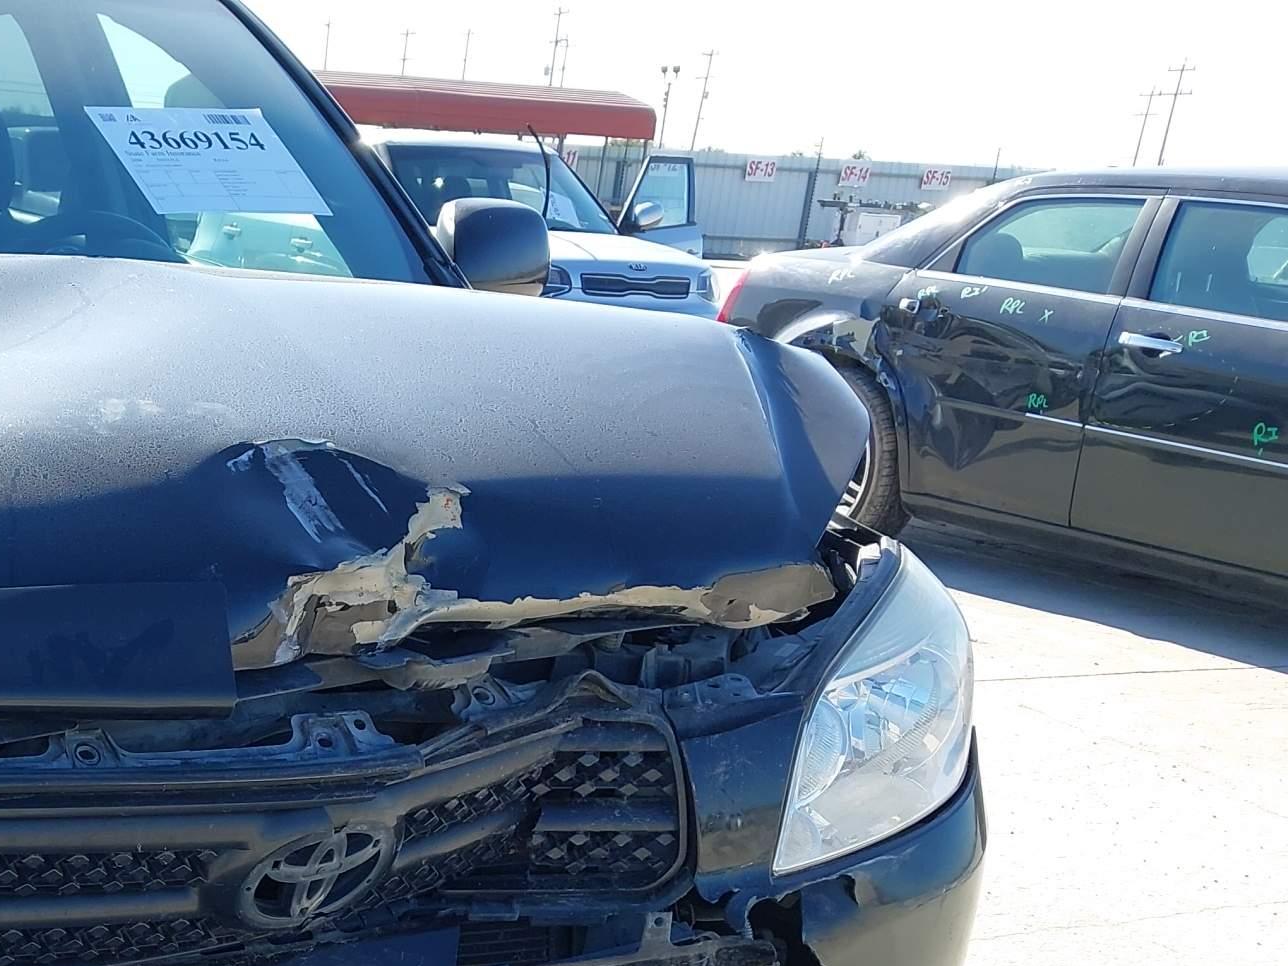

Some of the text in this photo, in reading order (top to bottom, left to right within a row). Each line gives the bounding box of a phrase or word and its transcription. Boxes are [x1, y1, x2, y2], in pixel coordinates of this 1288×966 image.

[128, 130, 265, 150] 43669154
[747, 160, 775, 177] SF-13
[841, 165, 869, 182] SF-14
[923, 169, 951, 186] SF-15
